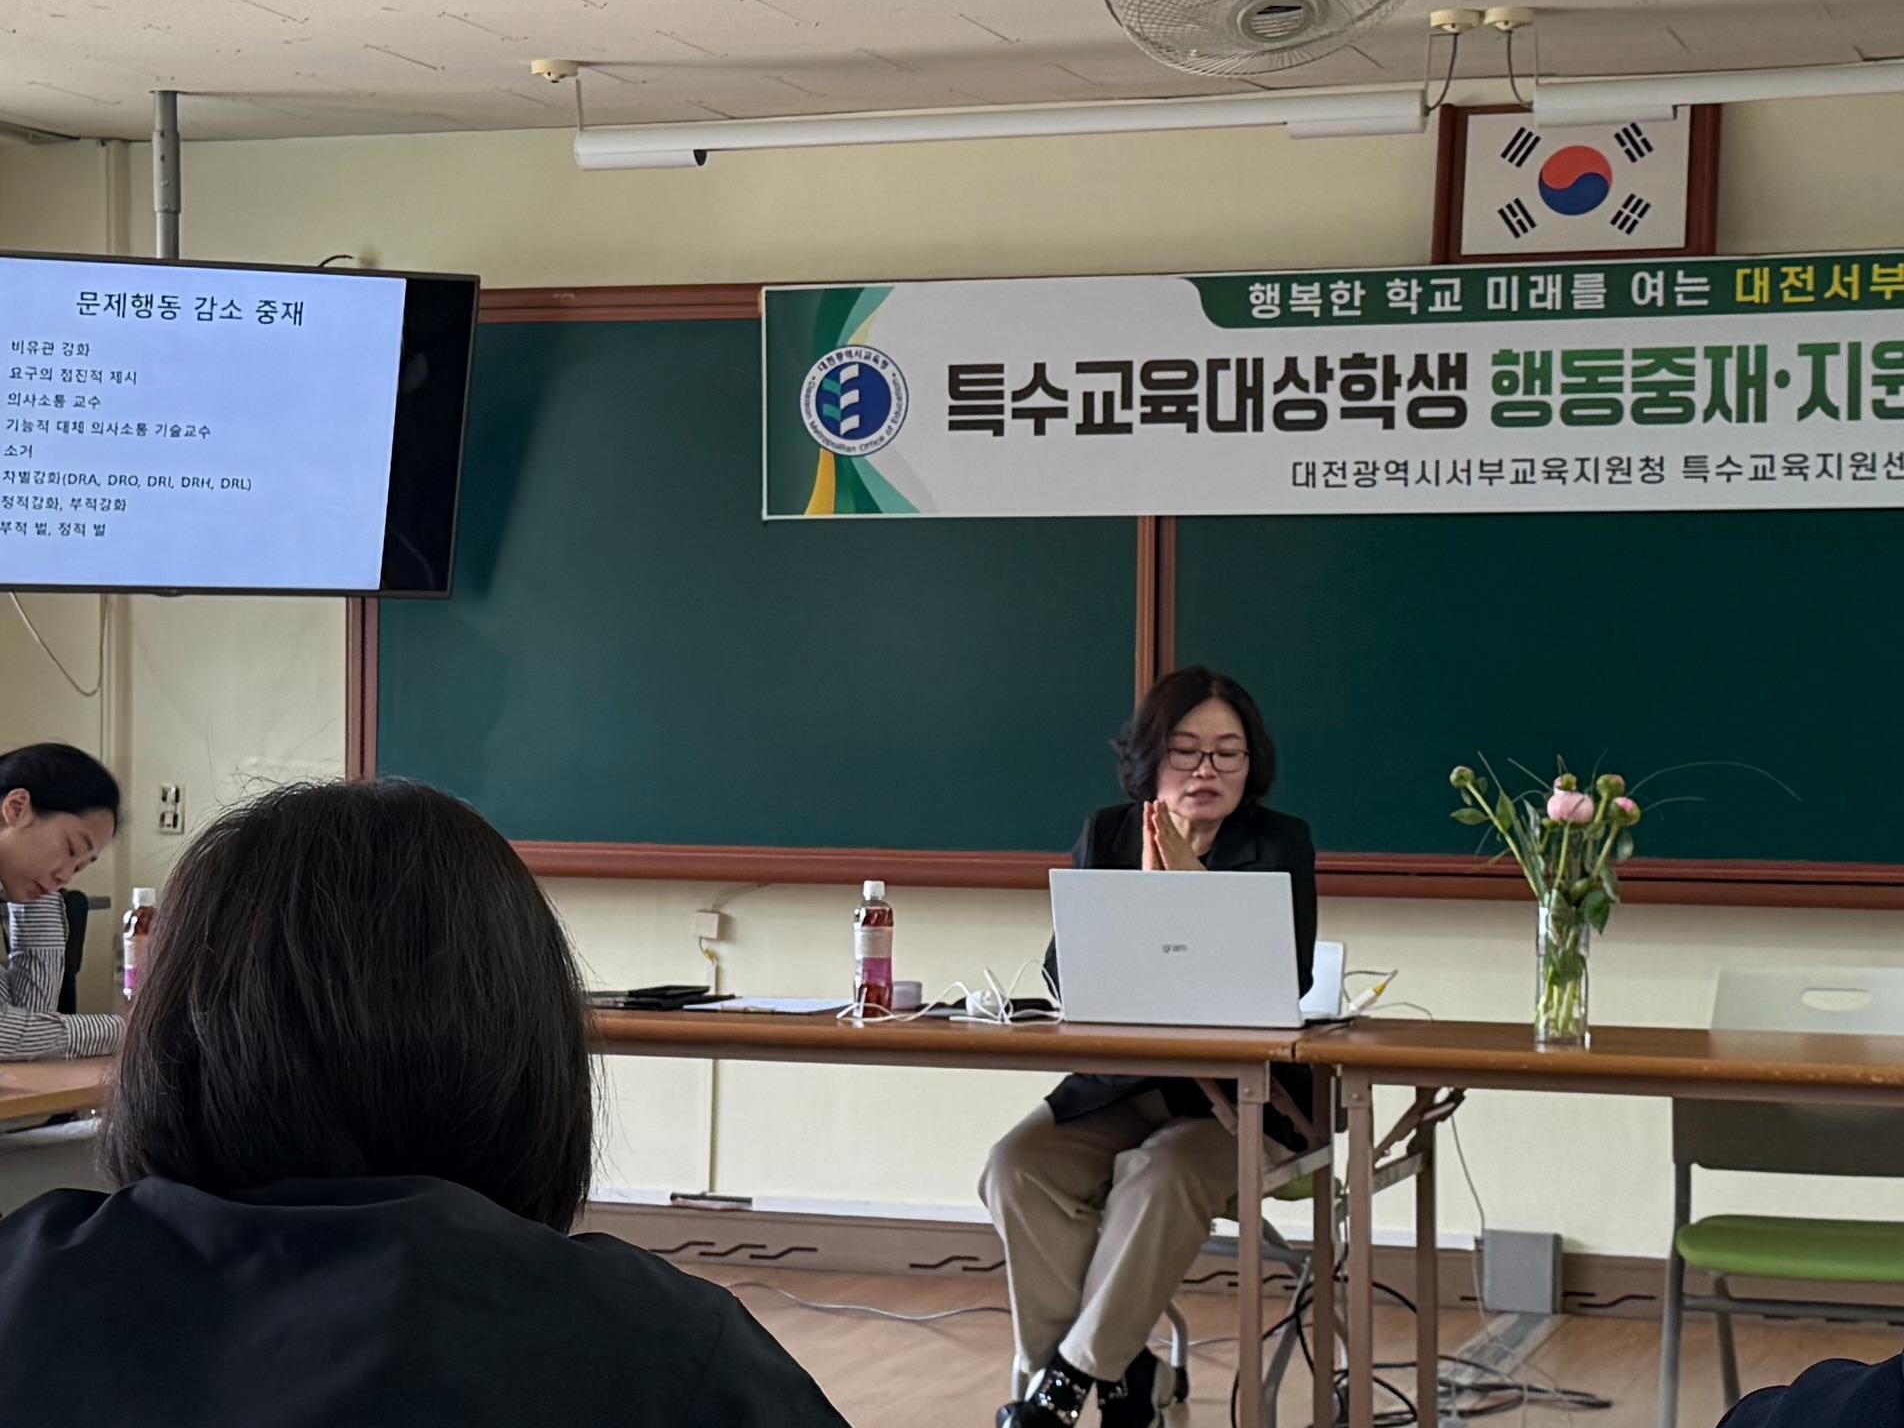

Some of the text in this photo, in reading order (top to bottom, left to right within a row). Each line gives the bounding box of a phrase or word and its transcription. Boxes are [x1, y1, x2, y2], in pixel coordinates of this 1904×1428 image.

[1248, 279, 1366, 319] 행복한
[1385, 277, 1463, 315] 학교
[1486, 273, 1607, 312] 미래를
[1630, 270, 1711, 308] 여는
[76, 291, 304, 326] 문제행동 감소 중재
[11, 340, 90, 357] 비유관 강화
[9, 366, 137, 385] 요구의 점진적 제시
[7, 392, 101, 410] 의사소통 교수
[947, 352, 1468, 436] 특수교육대상학생
[6, 418, 211, 439] 기능적 대체 의사소통 기술교수
[4, 444, 33, 458] 소거
[1292, 456, 1666, 489] 대전광역시서부교육지원청
[108, 474, 141, 488] DRO,
[220, 477, 252, 491] DRL)
[70, 497, 126, 512] 부적강화
[0, 521, 27, 536] 부적
[58, 522, 86, 537] 정적
